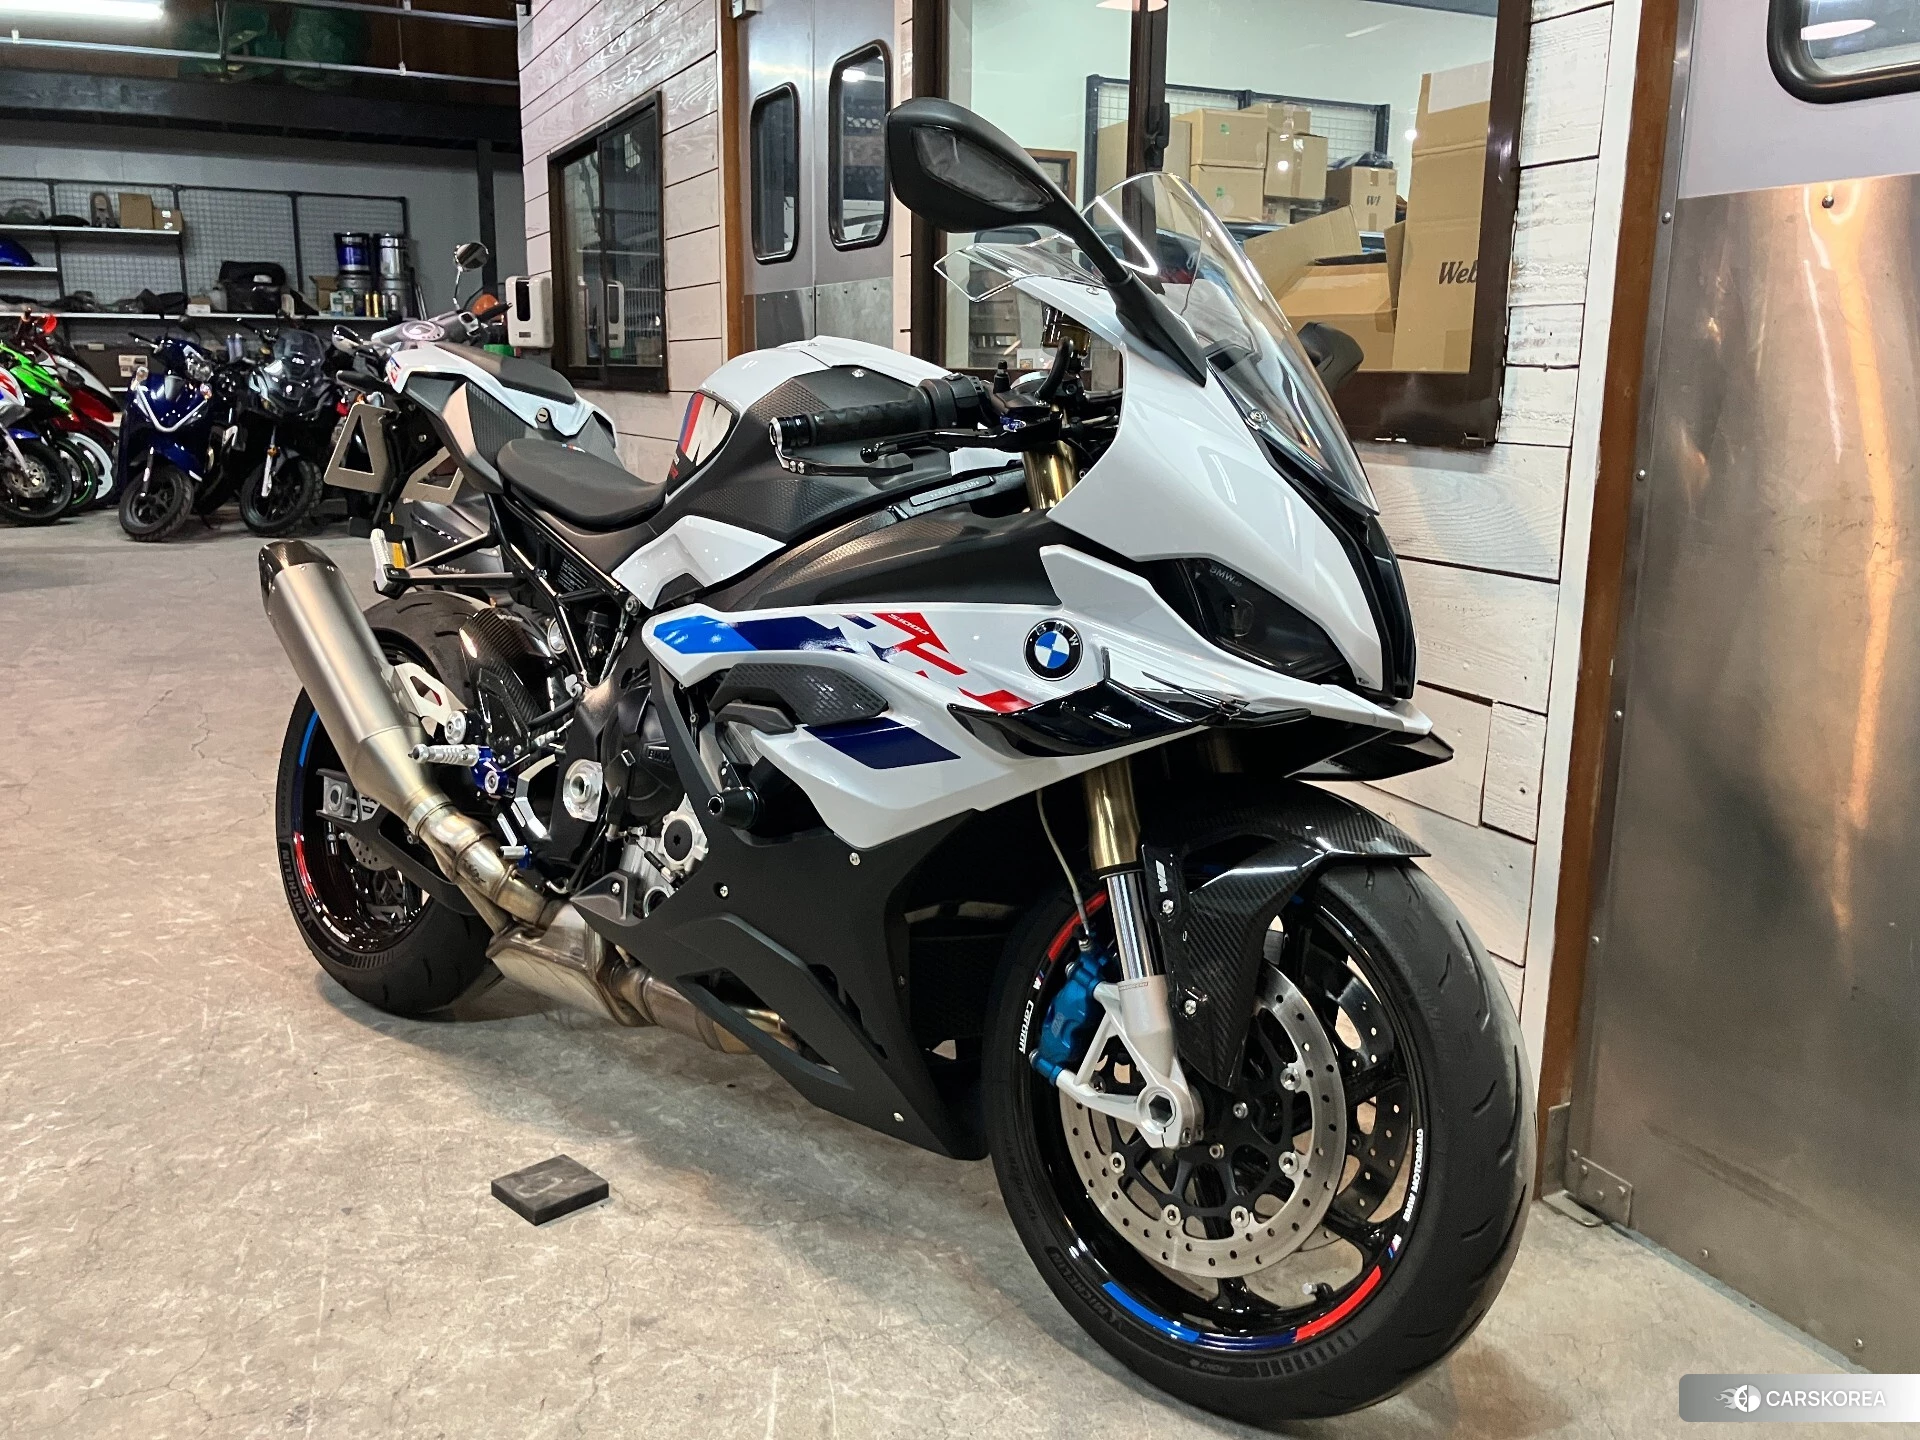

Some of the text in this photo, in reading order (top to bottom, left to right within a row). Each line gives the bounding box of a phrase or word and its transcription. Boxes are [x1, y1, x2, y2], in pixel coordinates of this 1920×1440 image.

[888, 613, 930, 636] S1000
[1035, 621, 1080, 647] BMW
[281, 849, 306, 916] MICHELIN
[1018, 1000, 1034, 1055] Carbon
[1402, 1192, 1416, 1222] BMW
[1411, 1128, 1424, 1194] MOTORRAD
